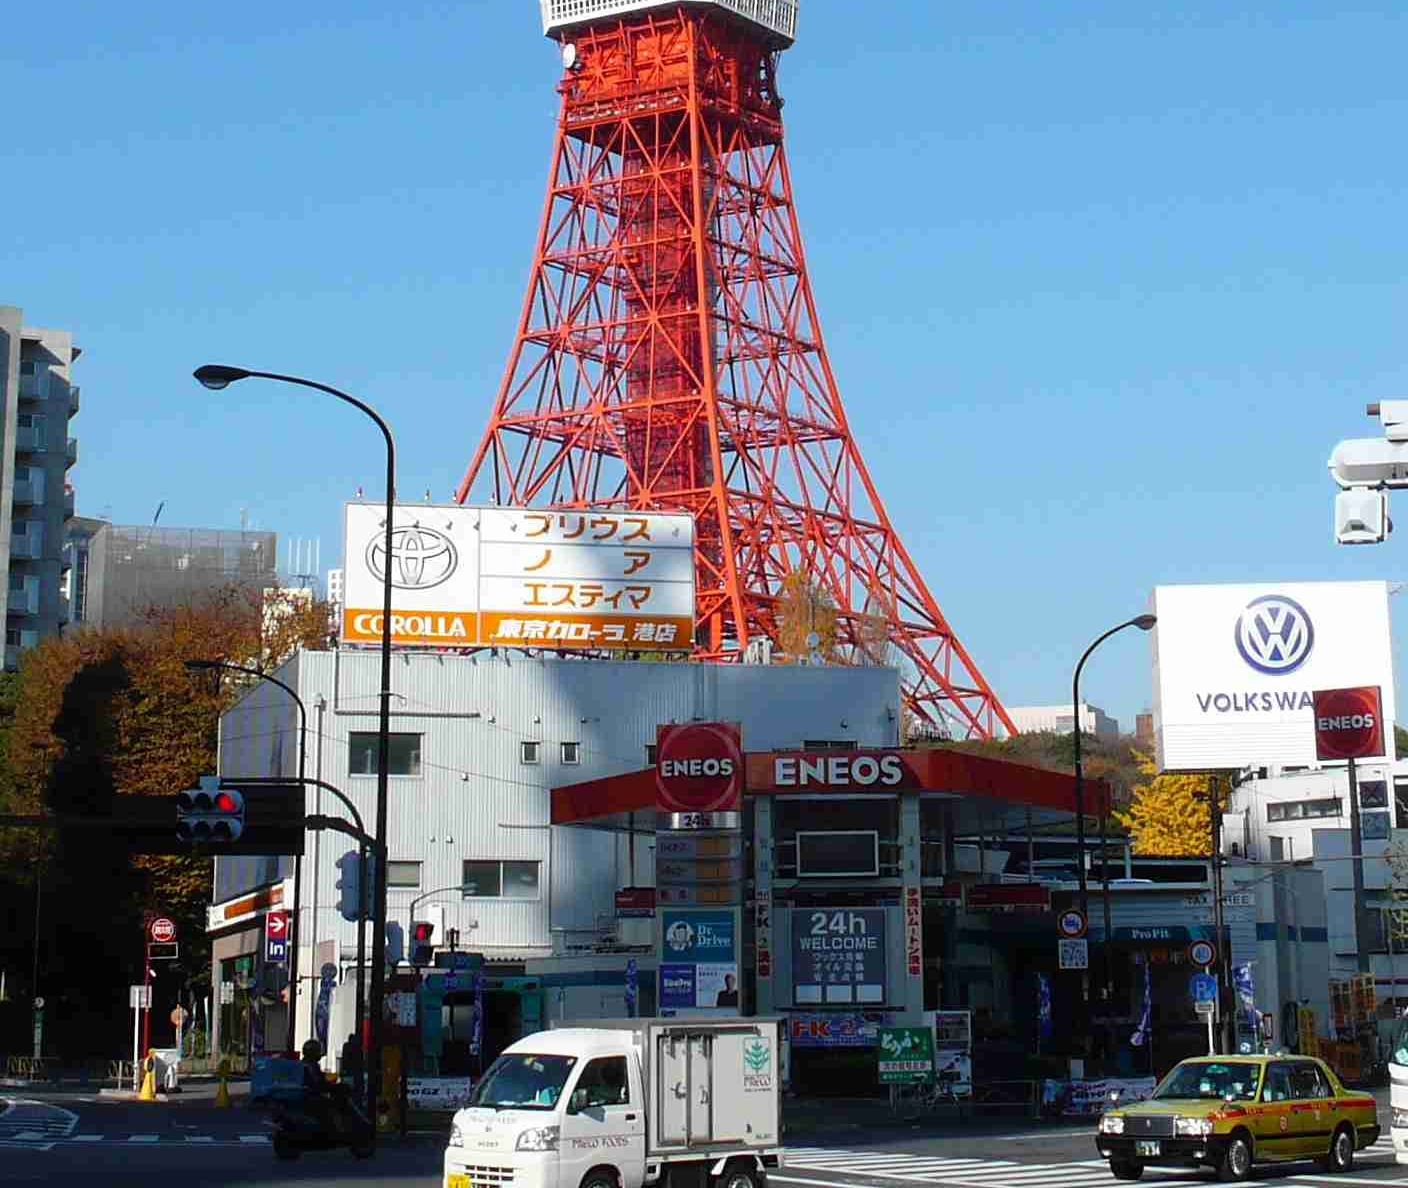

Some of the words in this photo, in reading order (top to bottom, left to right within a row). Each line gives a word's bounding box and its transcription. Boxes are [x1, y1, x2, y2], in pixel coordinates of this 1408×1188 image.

[524, 514, 652, 541] プリウス
[523, 583, 652, 610] エスティマ
[1196, 691, 1314, 713] VOLKSWA
[1317, 713, 1375, 731] ENEOS
[661, 757, 734, 778] ENEOS
[774, 755, 904, 786] ENEOS
[810, 912, 867, 935] 24h
[269, 941, 284, 955] In
[800, 937, 878, 950] WELCOME
